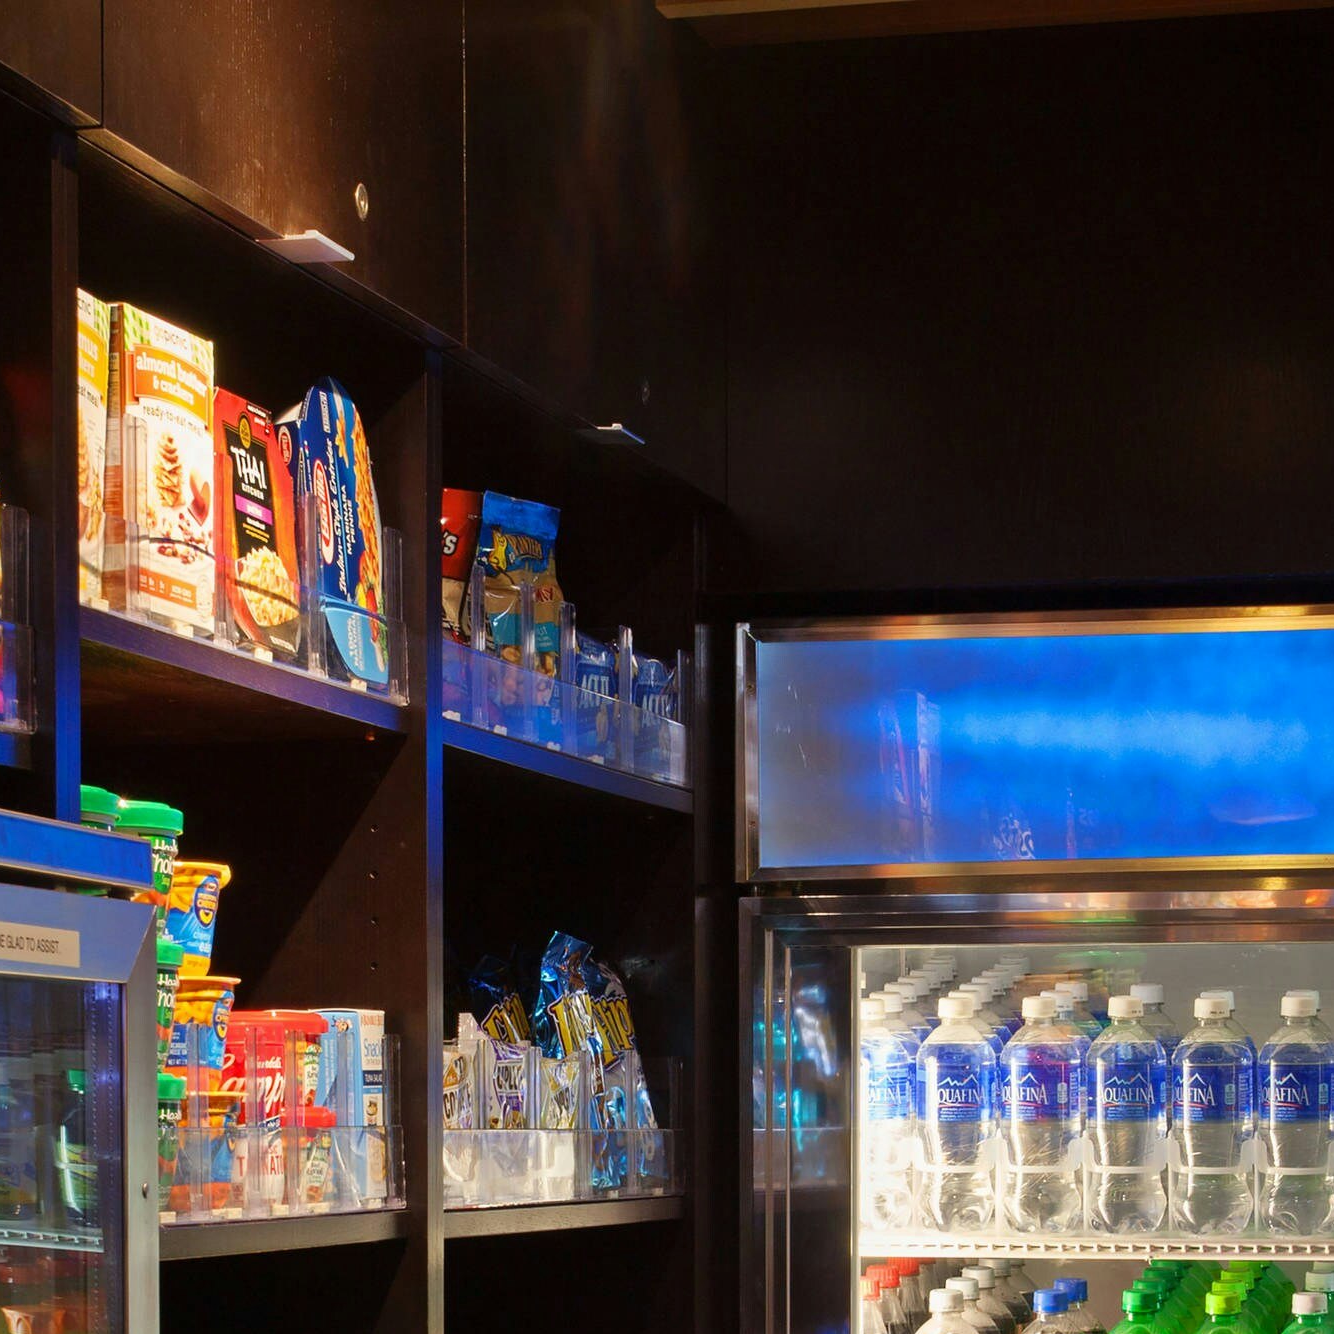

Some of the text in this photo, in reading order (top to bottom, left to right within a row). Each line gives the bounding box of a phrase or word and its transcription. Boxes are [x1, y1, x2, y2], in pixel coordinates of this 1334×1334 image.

[136, 352, 176, 379] almond
[230, 445, 268, 490] THAI
[341, 485, 354, 555] MARINARA
[346, 499, 356, 544] PENNE
[5, 933, 25, 950] GLAD
[26, 935, 36, 951] TO
